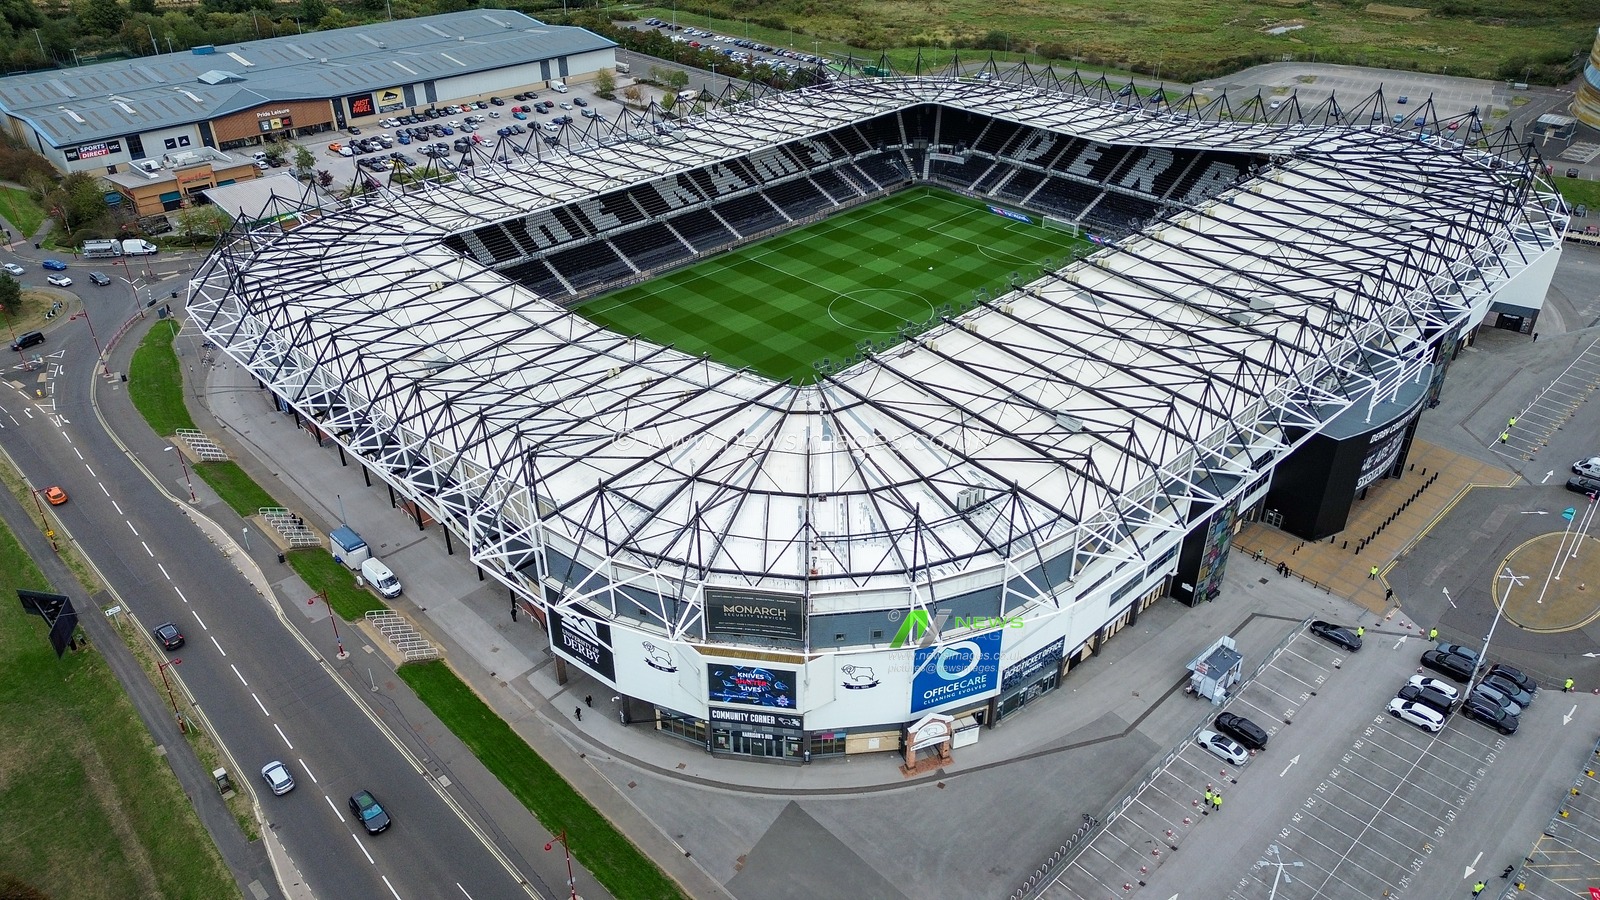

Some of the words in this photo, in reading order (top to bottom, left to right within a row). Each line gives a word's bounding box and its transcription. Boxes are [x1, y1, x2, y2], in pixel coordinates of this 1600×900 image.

[353, 99, 370, 107] JUST
[271, 108, 290, 116] Leisure
[353, 105, 372, 114] PADEL
[80, 143, 106, 153] SPORTS
[82, 149, 107, 159] DIRECT
[723, 605, 787, 617] MONARCH
[562, 628, 593, 650] UNIVERSITY
[563, 634, 600, 664] DERBY
[1021, 652, 1043, 669] TICKET
[737, 672, 765, 680] KNIVES
[1315, 675, 1326, 685] 327
[923, 674, 987, 699] OFFICECARE
[923, 693, 956, 705] CLEANING
[958, 684, 987, 695] EVOLVED
[1300, 692, 1310, 701] 326
[712, 710, 749, 722] COMMUNITY
[750, 713, 776, 725] CORNER
[1284, 708, 1295, 719] 325
[1267, 726, 1279, 737] 324
[1495, 739, 1506, 750] 277
[1316, 783, 1328, 794] 292
[1304, 797, 1316, 809] 294
[1445, 810, 1457, 822] 287
[1423, 842, 1435, 854] 291
[1411, 858, 1424, 872] 293
[1399, 875, 1412, 889] 295
[1517, 870, 1530, 884] 247
